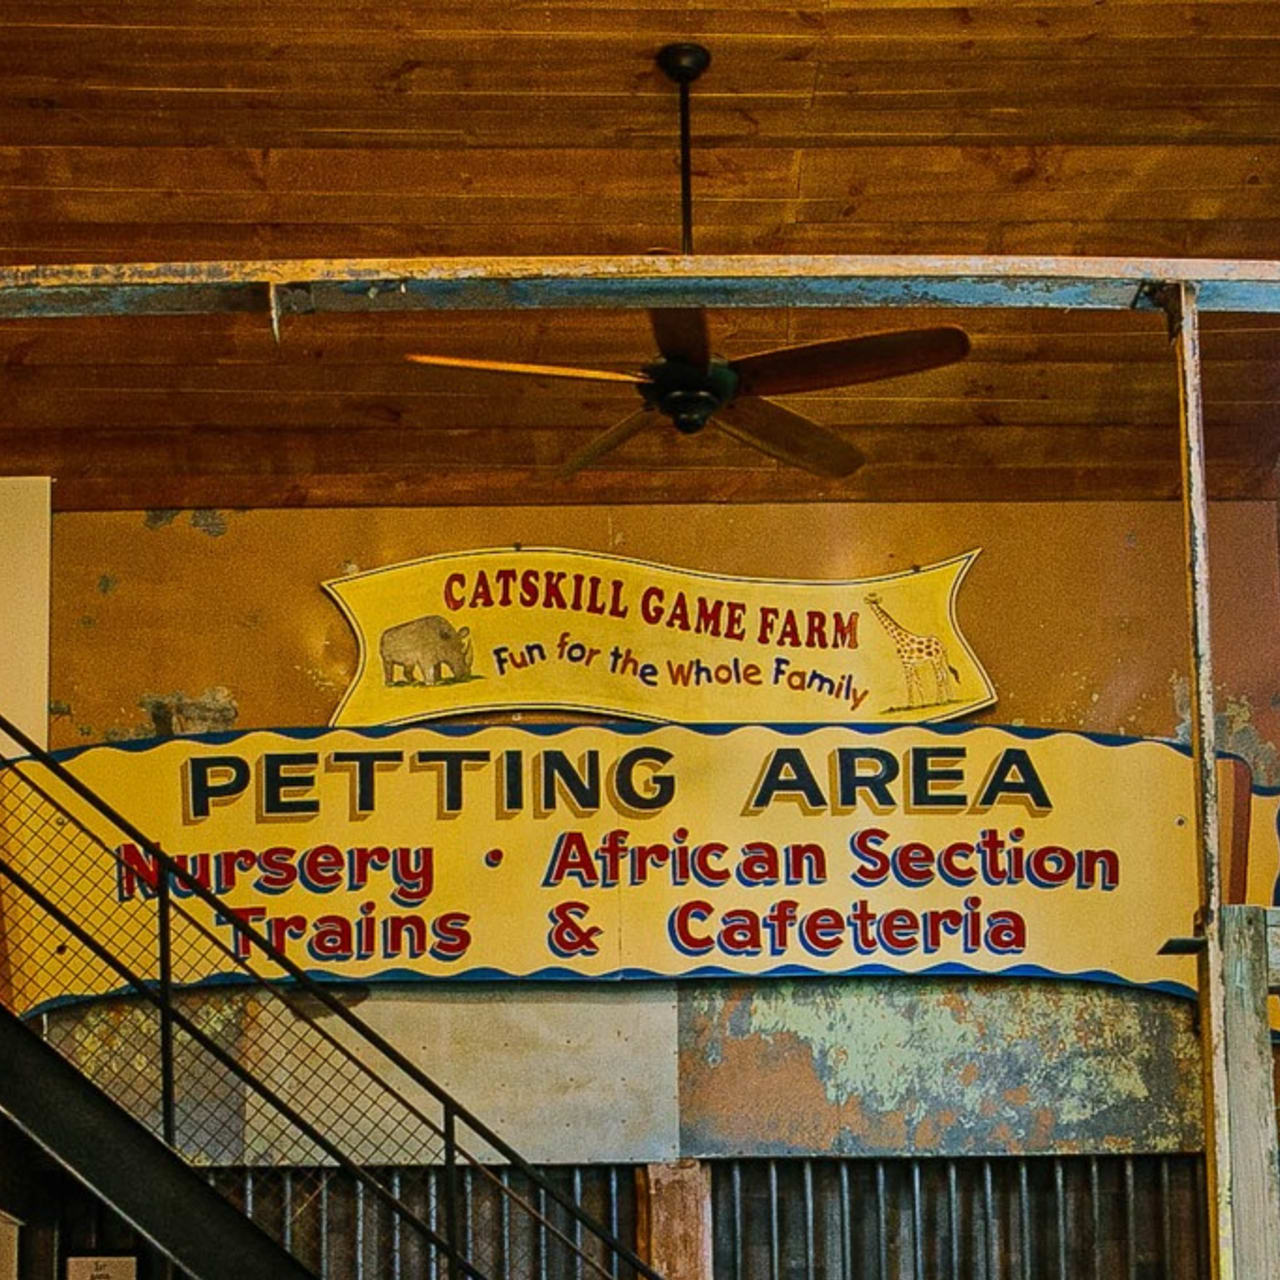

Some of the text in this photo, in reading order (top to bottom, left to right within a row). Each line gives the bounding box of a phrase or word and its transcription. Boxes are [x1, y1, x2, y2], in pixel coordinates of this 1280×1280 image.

[443, 569, 861, 651] CATSKILL GAME FARM
[493, 639, 547, 677] Fun
[556, 631, 603, 667] for
[609, 645, 659, 687] the
[773, 656, 869, 711] Family
[182, 746, 1054, 825] PETTING AREA
[116, 826, 1121, 907] Nursery African Section
[217, 896, 1028, 962] Trains & Cafeteria
